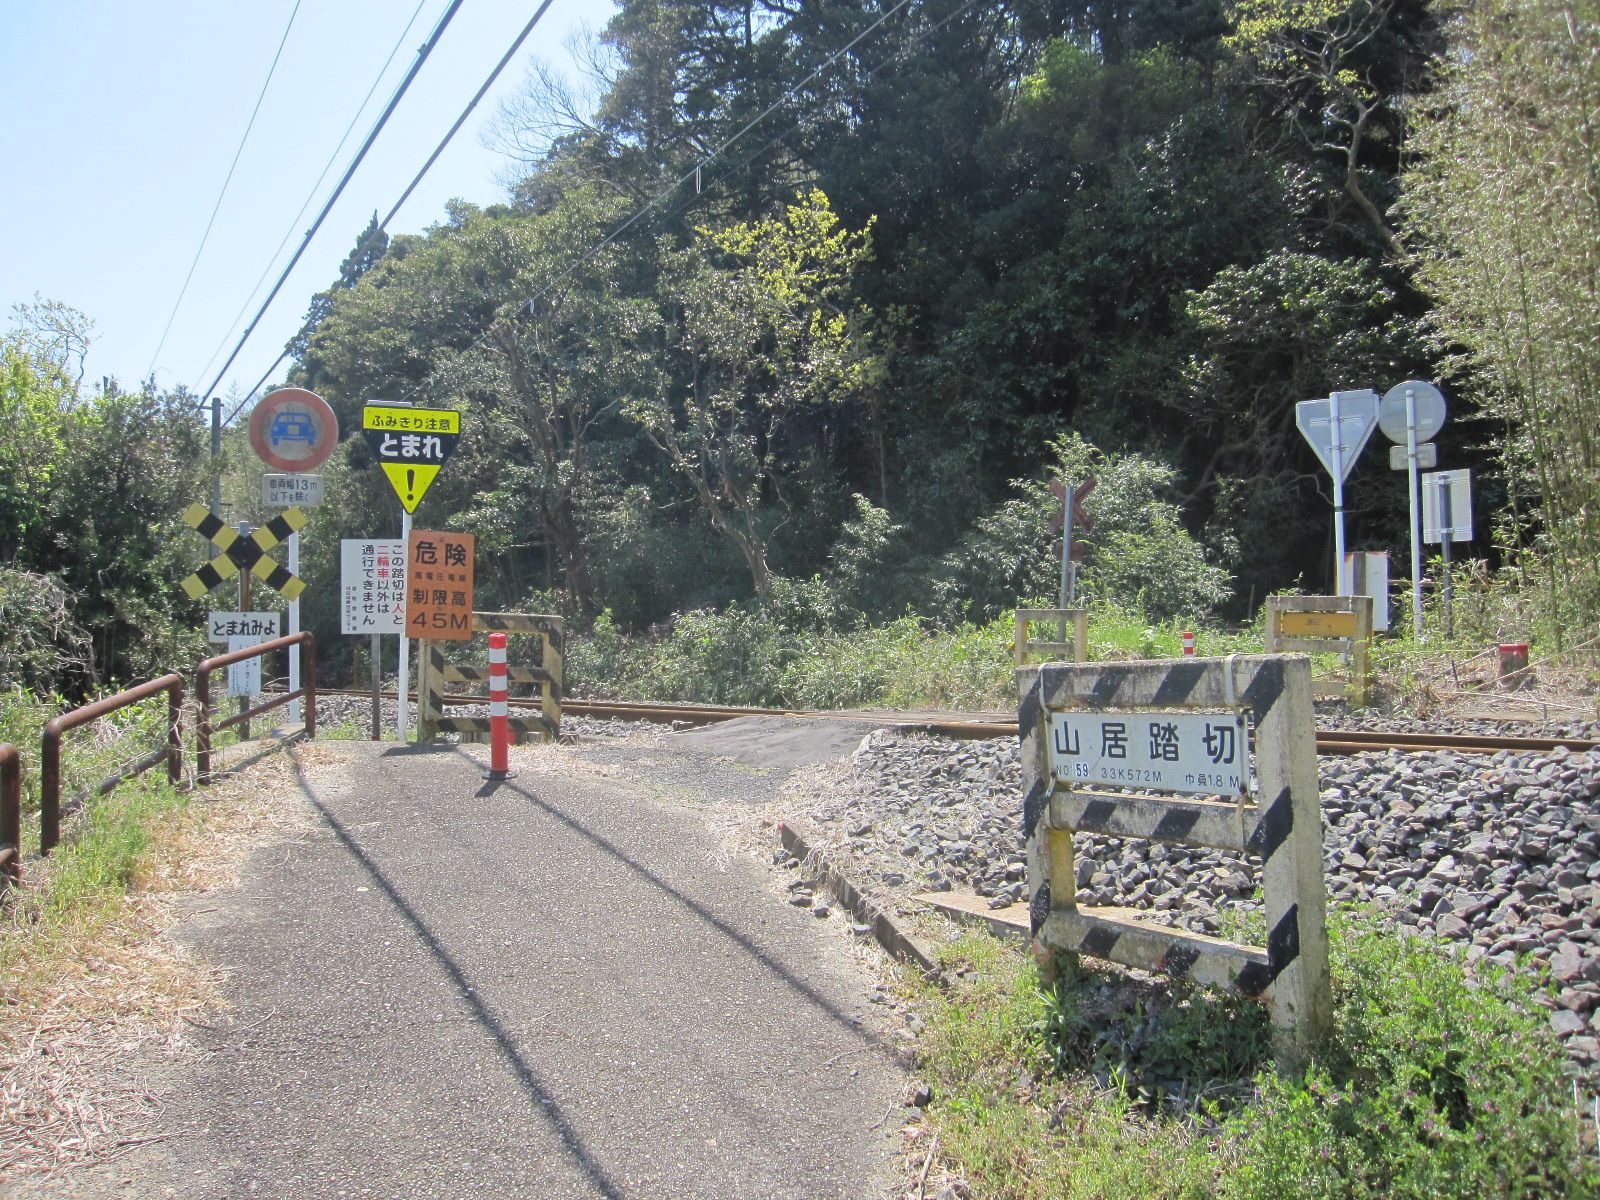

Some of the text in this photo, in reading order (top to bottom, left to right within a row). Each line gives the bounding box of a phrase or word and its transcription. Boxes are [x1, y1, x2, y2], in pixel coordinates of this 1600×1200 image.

[372, 415, 451, 431] ふみきり注意
[380, 433, 443, 458] とまれ
[415, 541, 467, 566] 危険
[362, 545, 375, 625] 通行できません
[377, 545, 389, 614] 二輪車以外は
[392, 545, 404, 625] この踏切は人と
[413, 589, 467, 606] 制限高
[213, 619, 275, 636] とまれみよ
[1054, 721, 1235, 764] 山居踏切
[1076, 763, 1089, 777] 59
[1101, 767, 1162, 782] 33K572M
